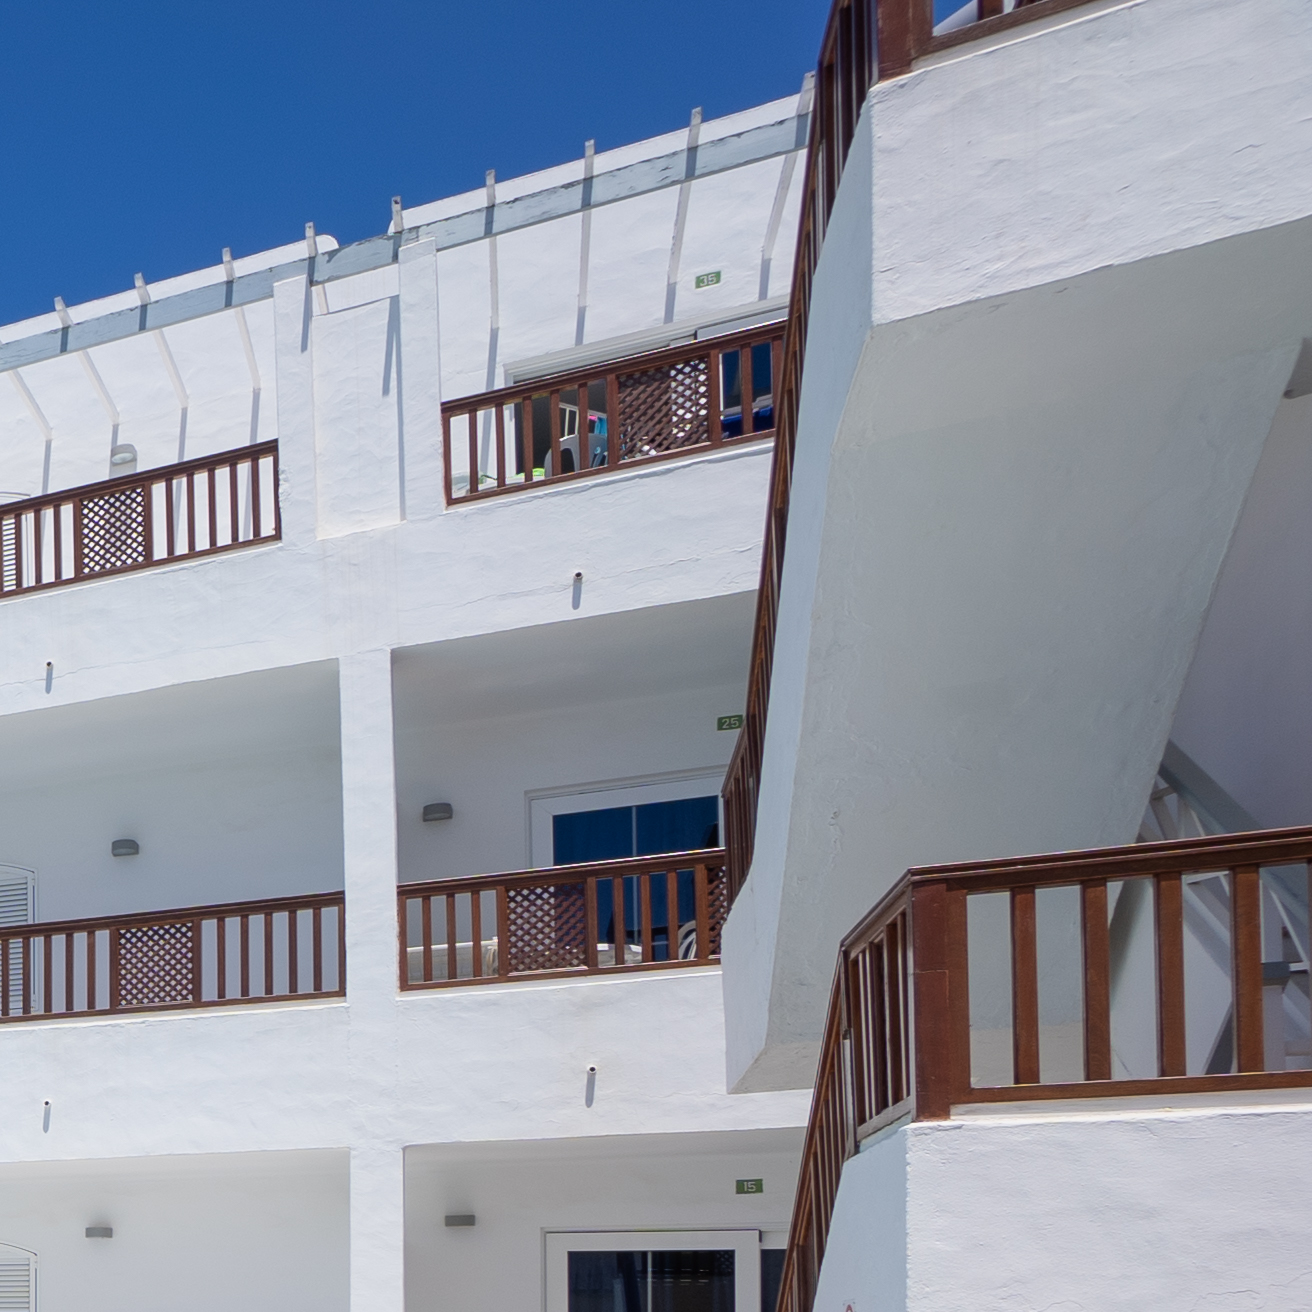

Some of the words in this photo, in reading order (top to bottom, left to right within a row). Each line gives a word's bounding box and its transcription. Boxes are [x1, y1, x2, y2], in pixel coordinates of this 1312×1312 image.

[699, 273, 717, 287] 35
[721, 717, 739, 729] 25
[743, 1181, 756, 1192] 15
